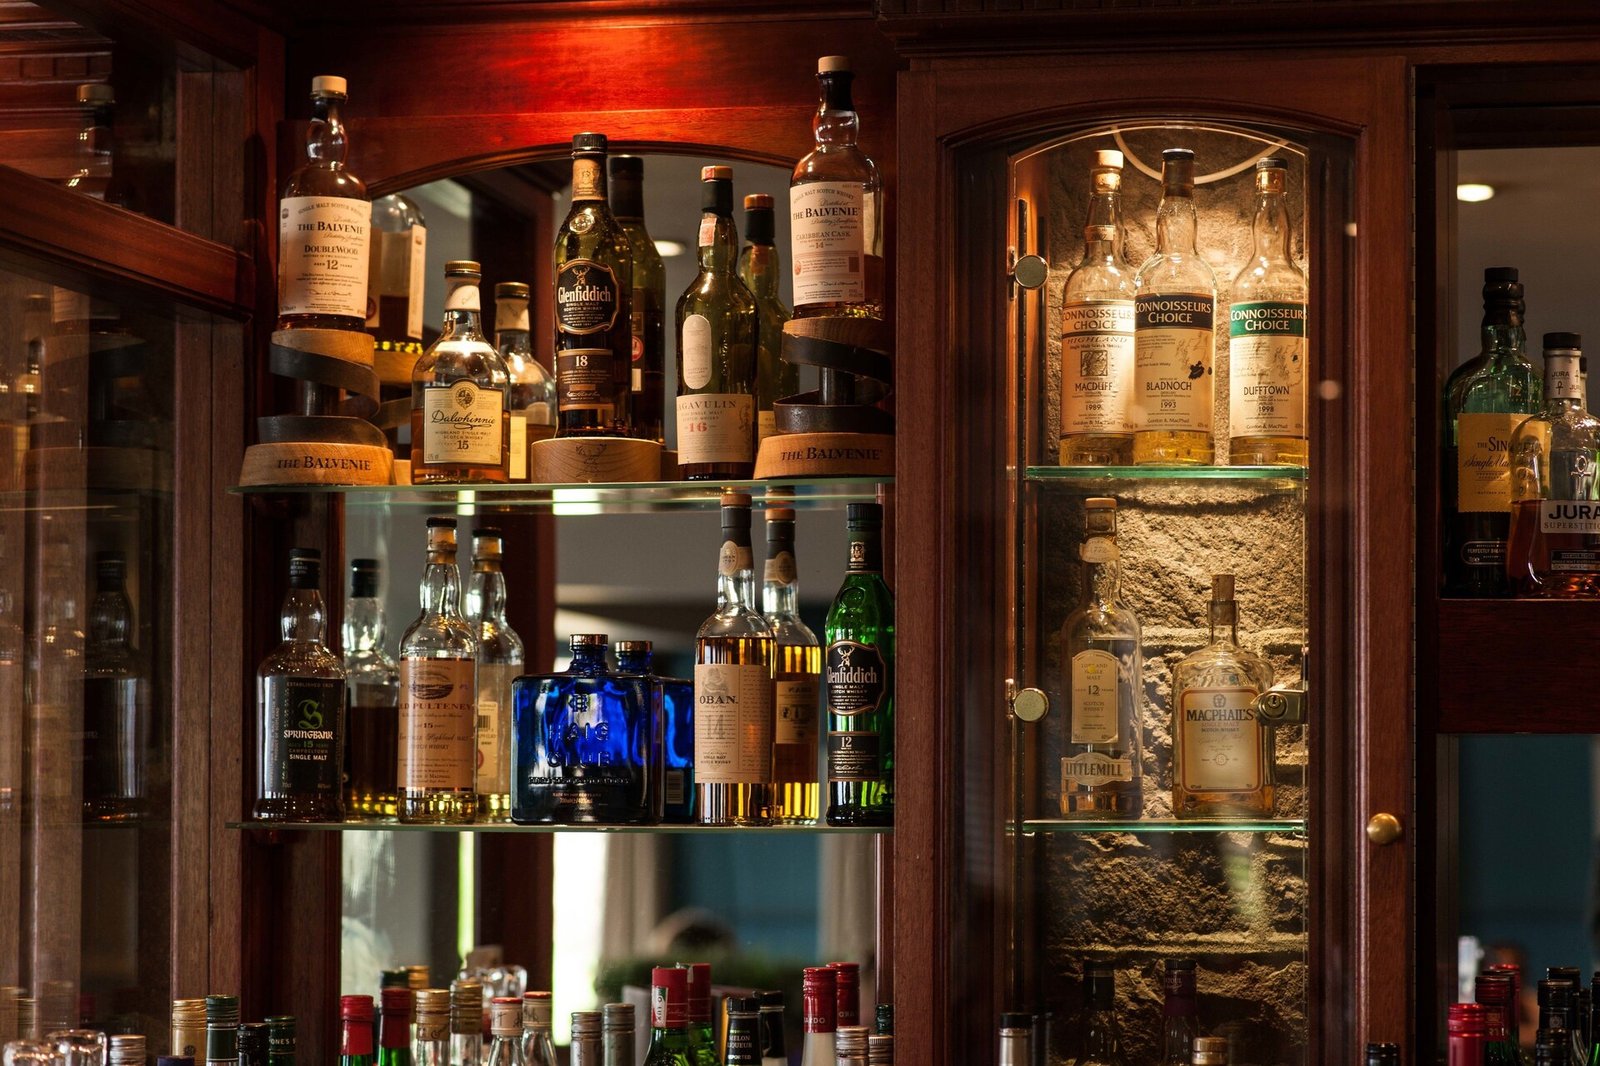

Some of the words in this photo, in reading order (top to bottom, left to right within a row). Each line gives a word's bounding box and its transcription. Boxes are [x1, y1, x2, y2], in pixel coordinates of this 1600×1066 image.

[792, 212, 804, 220] THE
[805, 208, 858, 218] BALVENIE
[318, 220, 364, 234] BALVENIE
[796, 232, 831, 240] CARIBBEAN
[304, 244, 358, 255] DOUBLEWOOD
[326, 260, 338, 270] 12
[558, 286, 611, 304] Glenfiddich
[1135, 300, 1212, 314] CONNOISSEURS
[1148, 312, 1193, 324] CHOICE
[1230, 308, 1308, 322] CONNOISSEURS
[1073, 320, 1117, 330] CHOICE
[1244, 320, 1290, 331] CHOICE
[575, 355, 588, 367] 18
[1074, 381, 1113, 392] MACDUFF
[1146, 380, 1192, 391] BLADNOCH
[1243, 386, 1290, 396] DUFFTOWN
[431, 409, 496, 426] Dalwhinnie
[689, 422, 708, 432] 16
[457, 440, 469, 450] 15
[782, 452, 804, 460] THE
[806, 446, 880, 460] BALVENIE
[277, 459, 300, 469] THE
[304, 456, 372, 470] BALVENIE
[1548, 505, 1600, 520] JURA
[1088, 685, 1100, 696] 12
[1186, 708, 1254, 721] MACPHAIL'S
[283, 730, 333, 740] SPRINGBANK
[841, 736, 852, 748] 12
